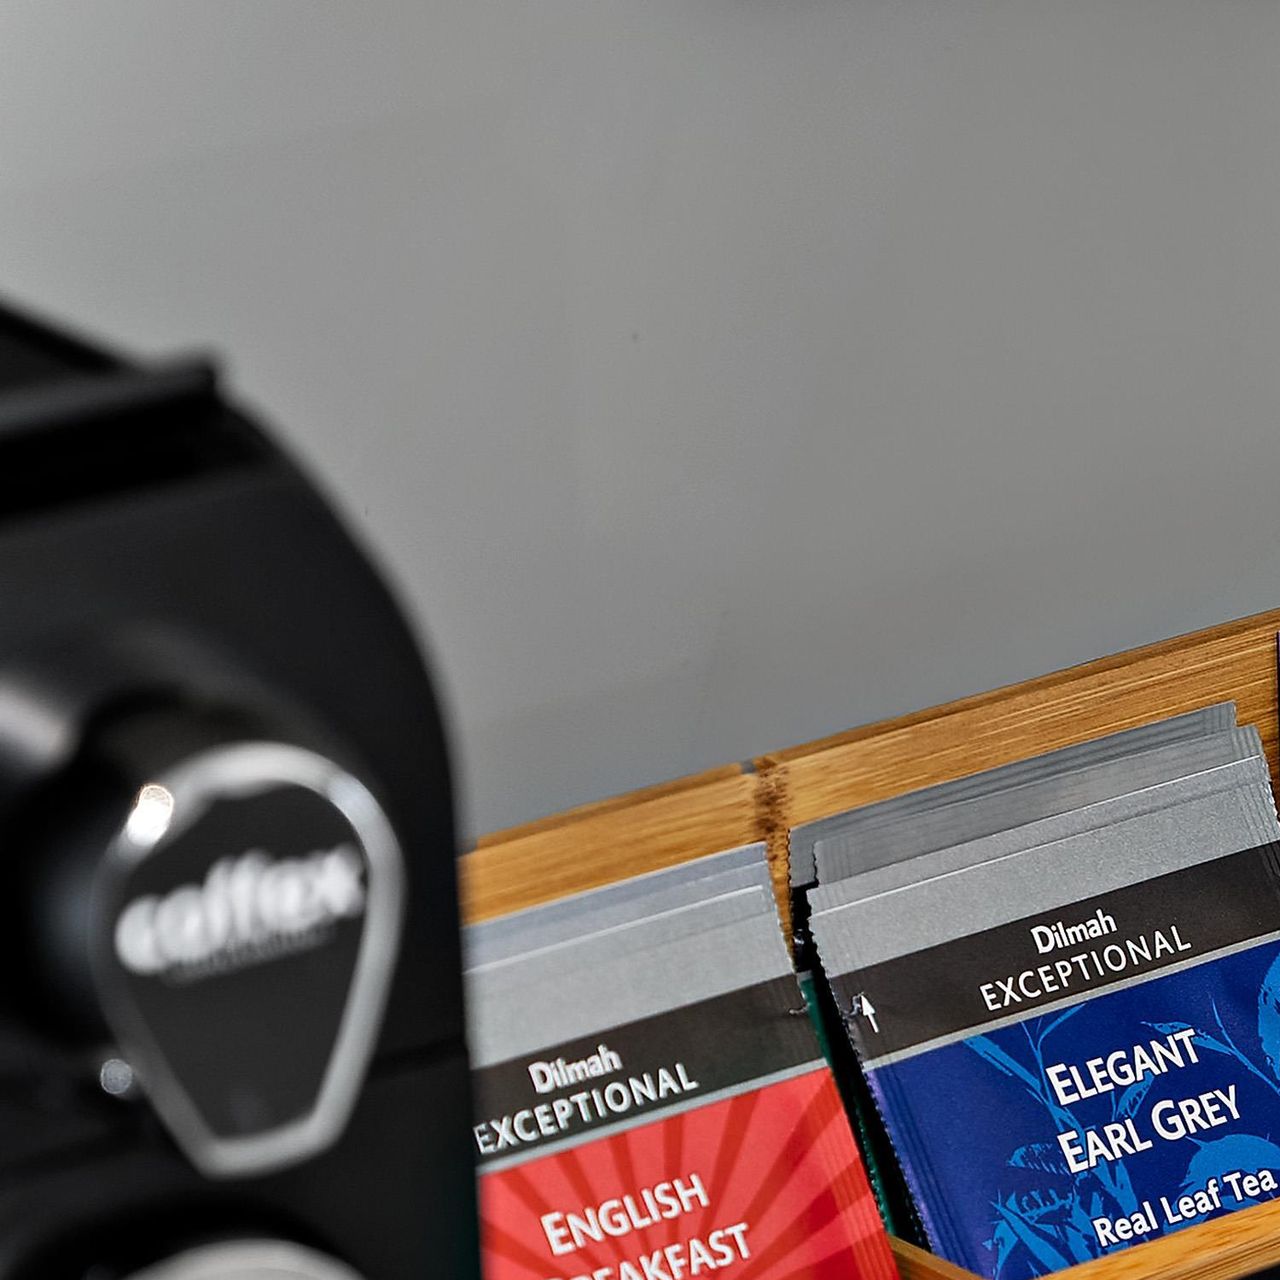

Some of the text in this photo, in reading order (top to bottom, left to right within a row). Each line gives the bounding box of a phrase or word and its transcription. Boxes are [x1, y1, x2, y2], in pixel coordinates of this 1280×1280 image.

[979, 925, 1192, 1012] EXCEPTIONAL
[1031, 909, 1117, 955] Dilmah
[473, 1062, 699, 1155] EXCEPTIONAL
[529, 1044, 623, 1094] Dilmah
[1045, 1029, 1200, 1106] ELEGANT
[1057, 1083, 1244, 1174] EARL GREY
[540, 1173, 710, 1256] ENGLISH
[1092, 1165, 1279, 1249] Real Leaf Tea
